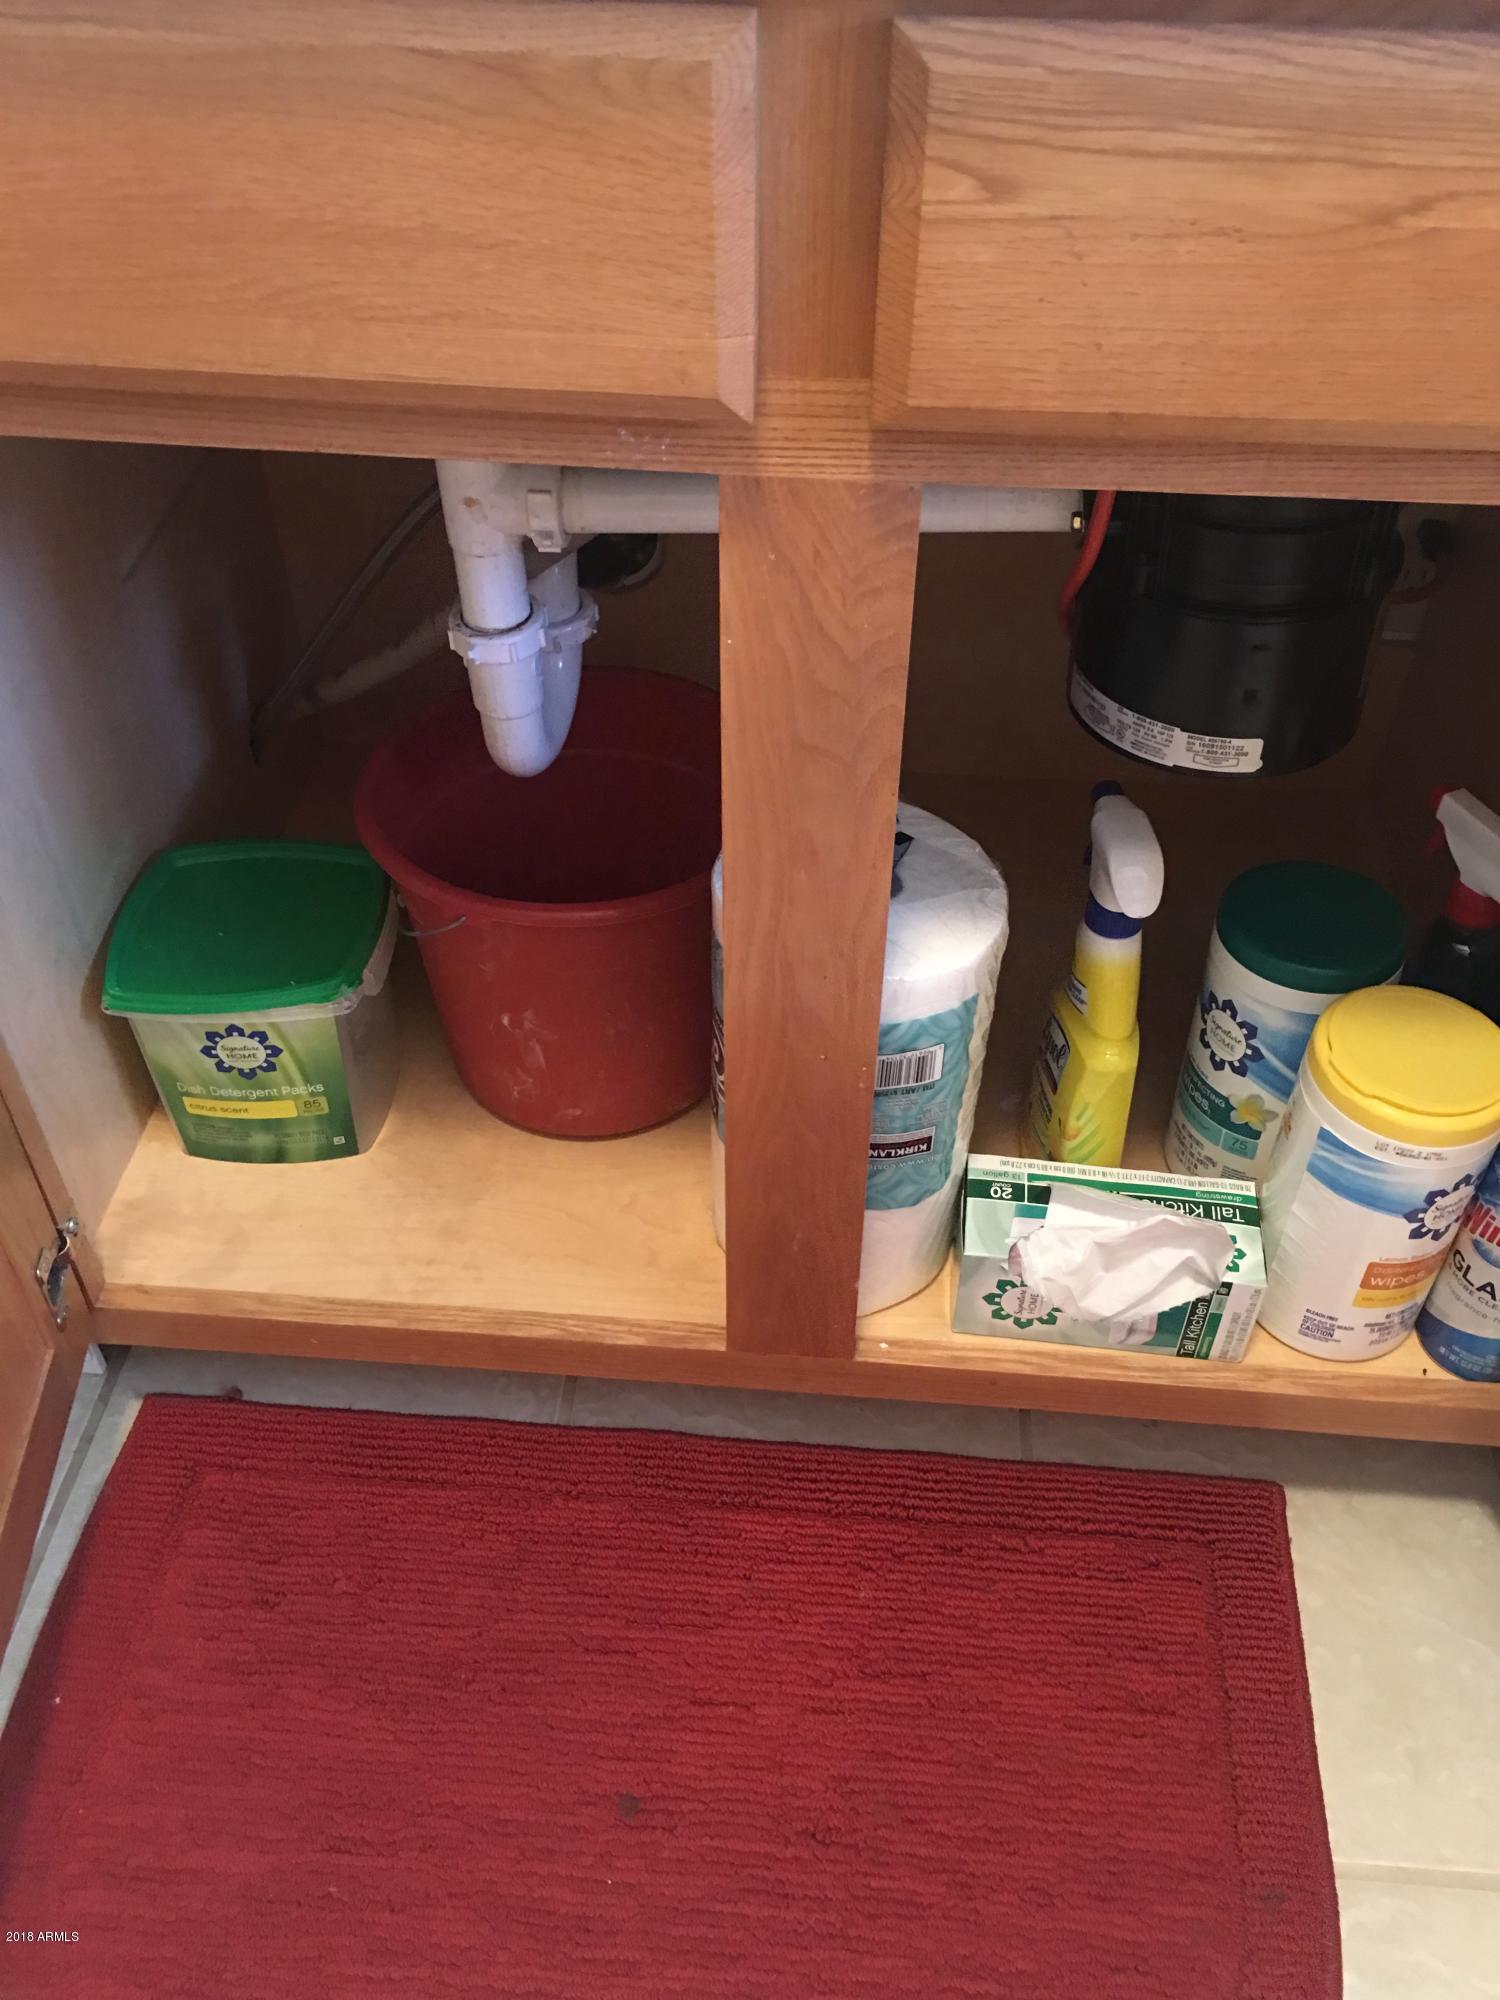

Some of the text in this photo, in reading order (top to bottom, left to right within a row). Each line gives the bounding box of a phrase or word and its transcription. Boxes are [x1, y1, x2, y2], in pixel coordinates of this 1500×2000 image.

[1211, 1014, 1242, 1045] Signature
[1210, 1027, 1235, 1051] HOME
[220, 1044, 259, 1052] Signature
[226, 1052, 258, 1060] HOME
[176, 1082, 324, 1099] Dish Detergent Packs
[189, 1102, 218, 1112] citrus
[304, 1100, 321, 1109] 85
[1230, 1138, 1248, 1150] 75
[1150, 1175, 1175, 1185] CAPACITY
[990, 1186, 1012, 1199] 20
[1196, 1191, 1242, 1202] drawstring
[1212, 1206, 1245, 1222] Tall
[1370, 1270, 1426, 1288] wipes
[1453, 1249, 1500, 1302] GLA
[1186, 1302, 1209, 1338] Kitchen
[1306, 1308, 1326, 1320] BLEACH
[1300, 1323, 1334, 1338] CAUTION
[1180, 1340, 1196, 1355] Tall
